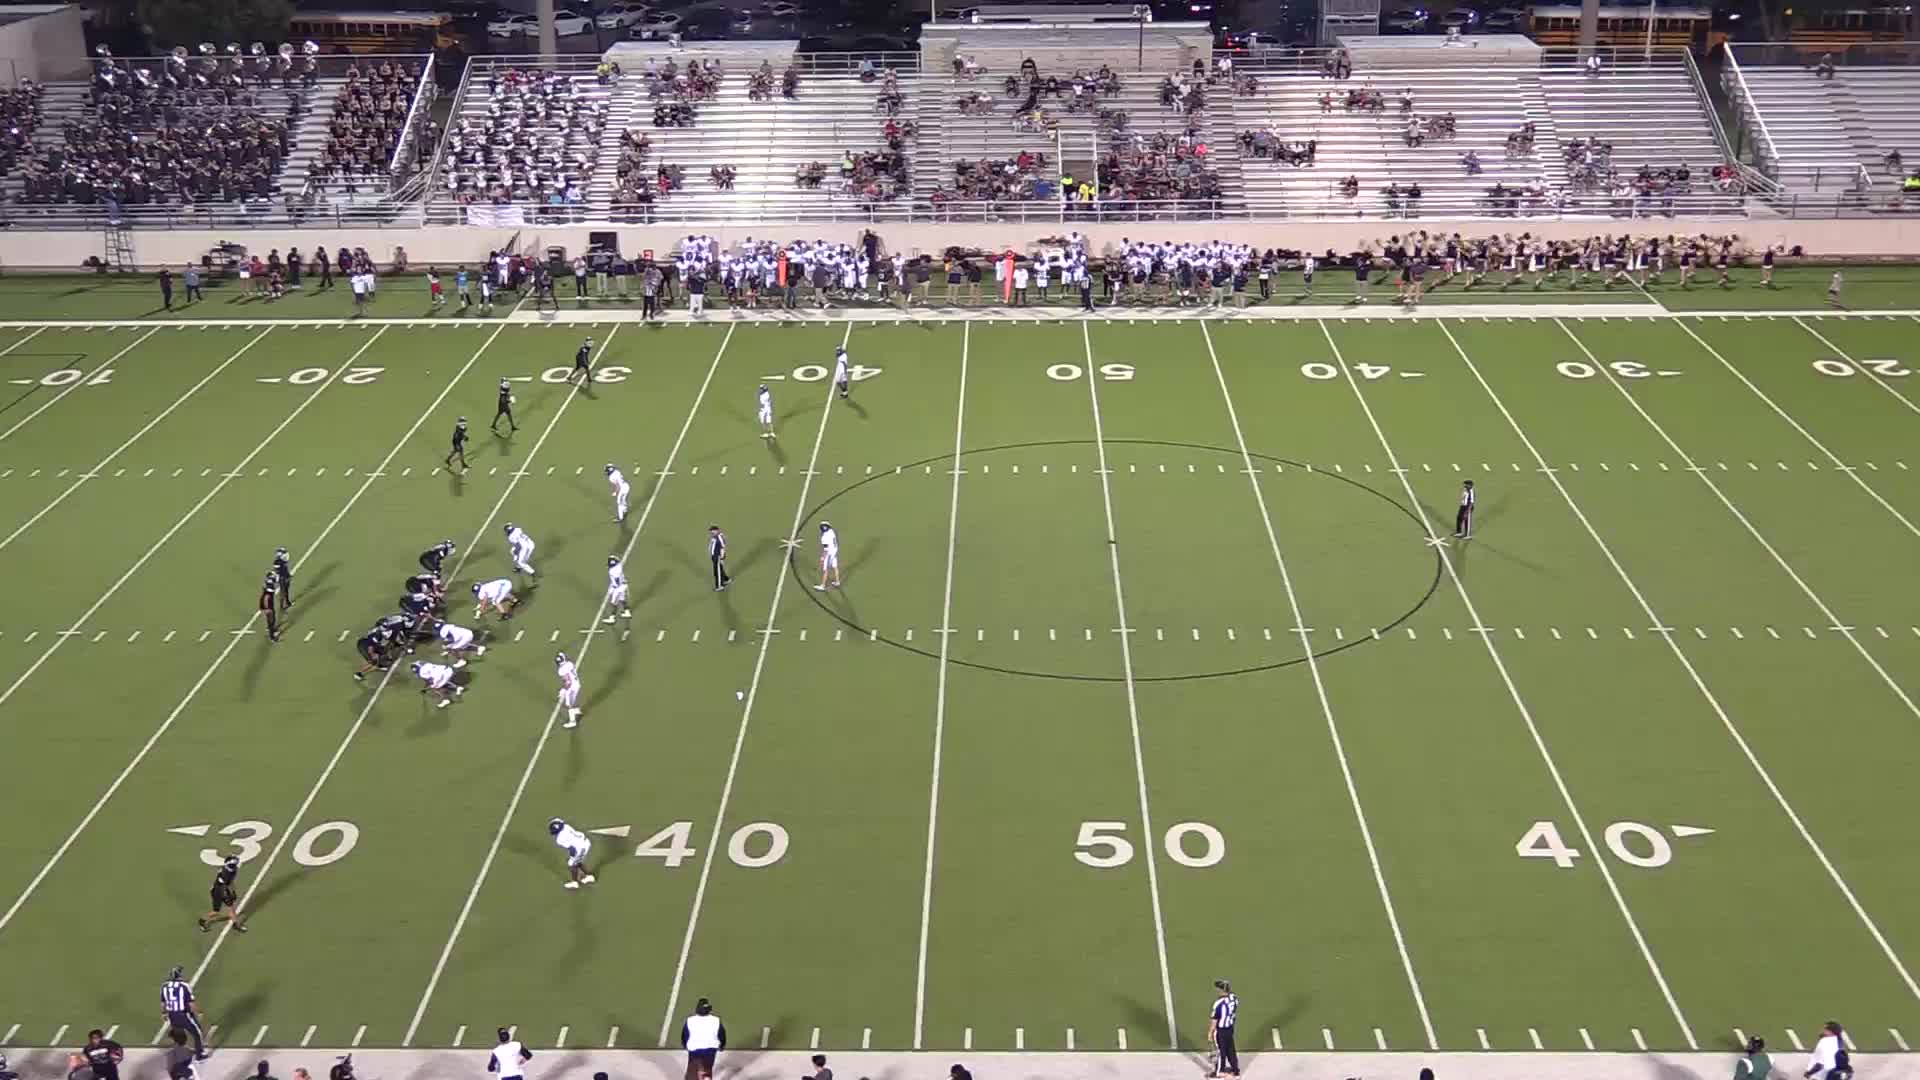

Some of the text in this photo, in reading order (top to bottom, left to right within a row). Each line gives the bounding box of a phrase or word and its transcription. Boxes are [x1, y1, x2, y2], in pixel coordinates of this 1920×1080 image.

[1046, 363, 1137, 381] 50
[1300, 362, 1391, 380] 40
[1556, 361, 1652, 379] 30
[1812, 359, 1912, 377] 20
[200, 820, 360, 867] 30
[634, 821, 790, 868] 40
[1074, 821, 1226, 868] 50
[1515, 821, 1672, 868] 40
